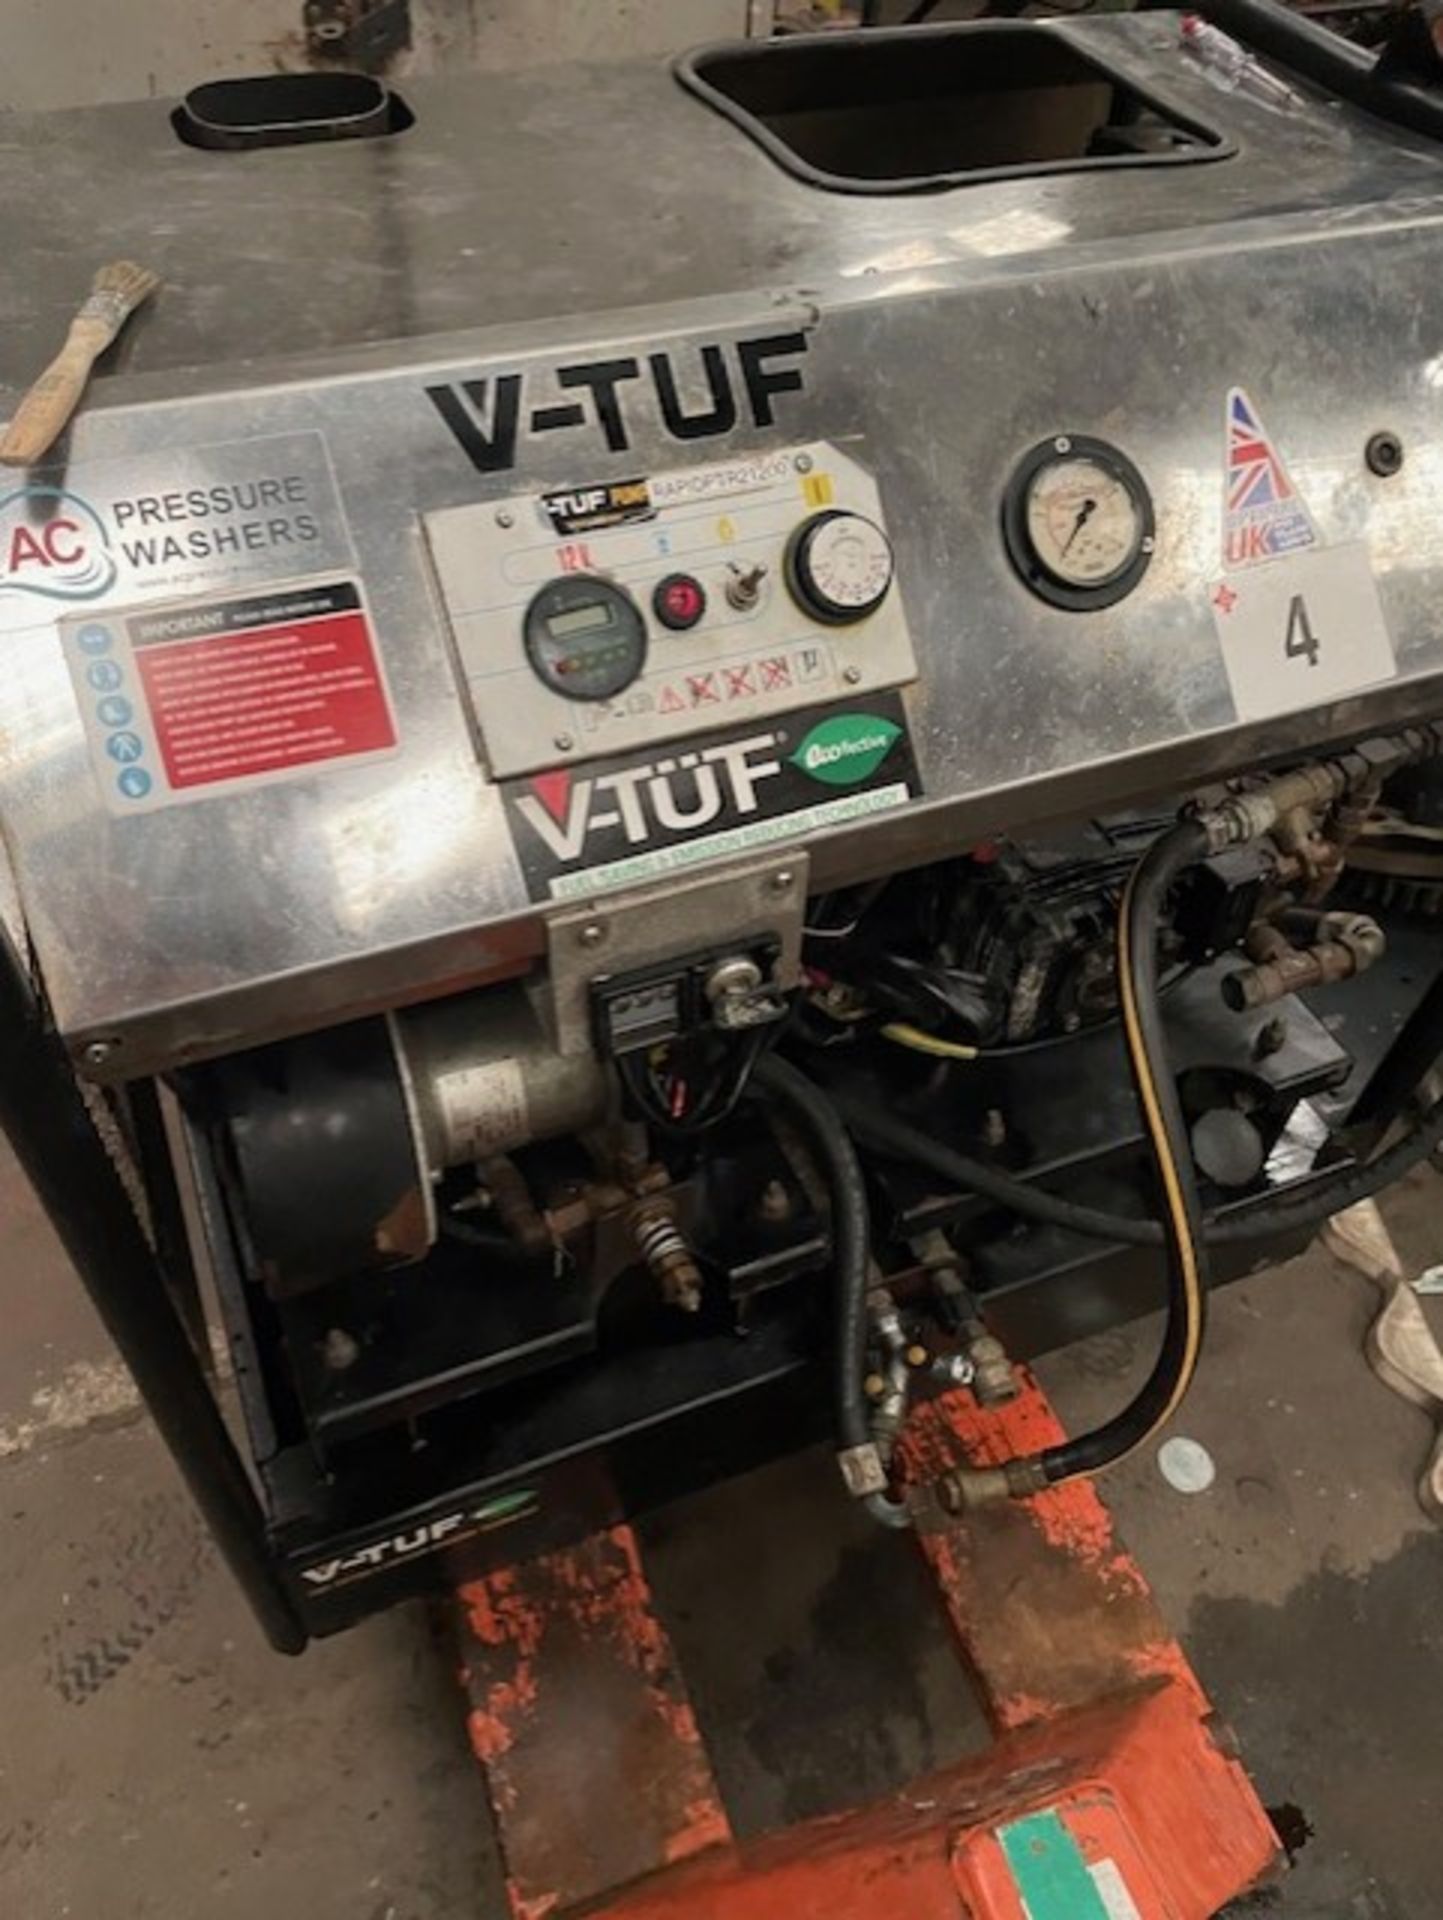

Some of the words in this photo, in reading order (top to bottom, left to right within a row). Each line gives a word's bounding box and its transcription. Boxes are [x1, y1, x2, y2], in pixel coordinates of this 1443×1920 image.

[425, 332, 808, 473] V-TUF
[113, 477, 306, 529] PRESSURE
[9, 520, 84, 572] AC
[122, 515, 318, 569] WASHERS
[1226, 521, 1267, 562] UK
[1285, 595, 1320, 665] 4
[302, 1513, 464, 1583] V-TUF
